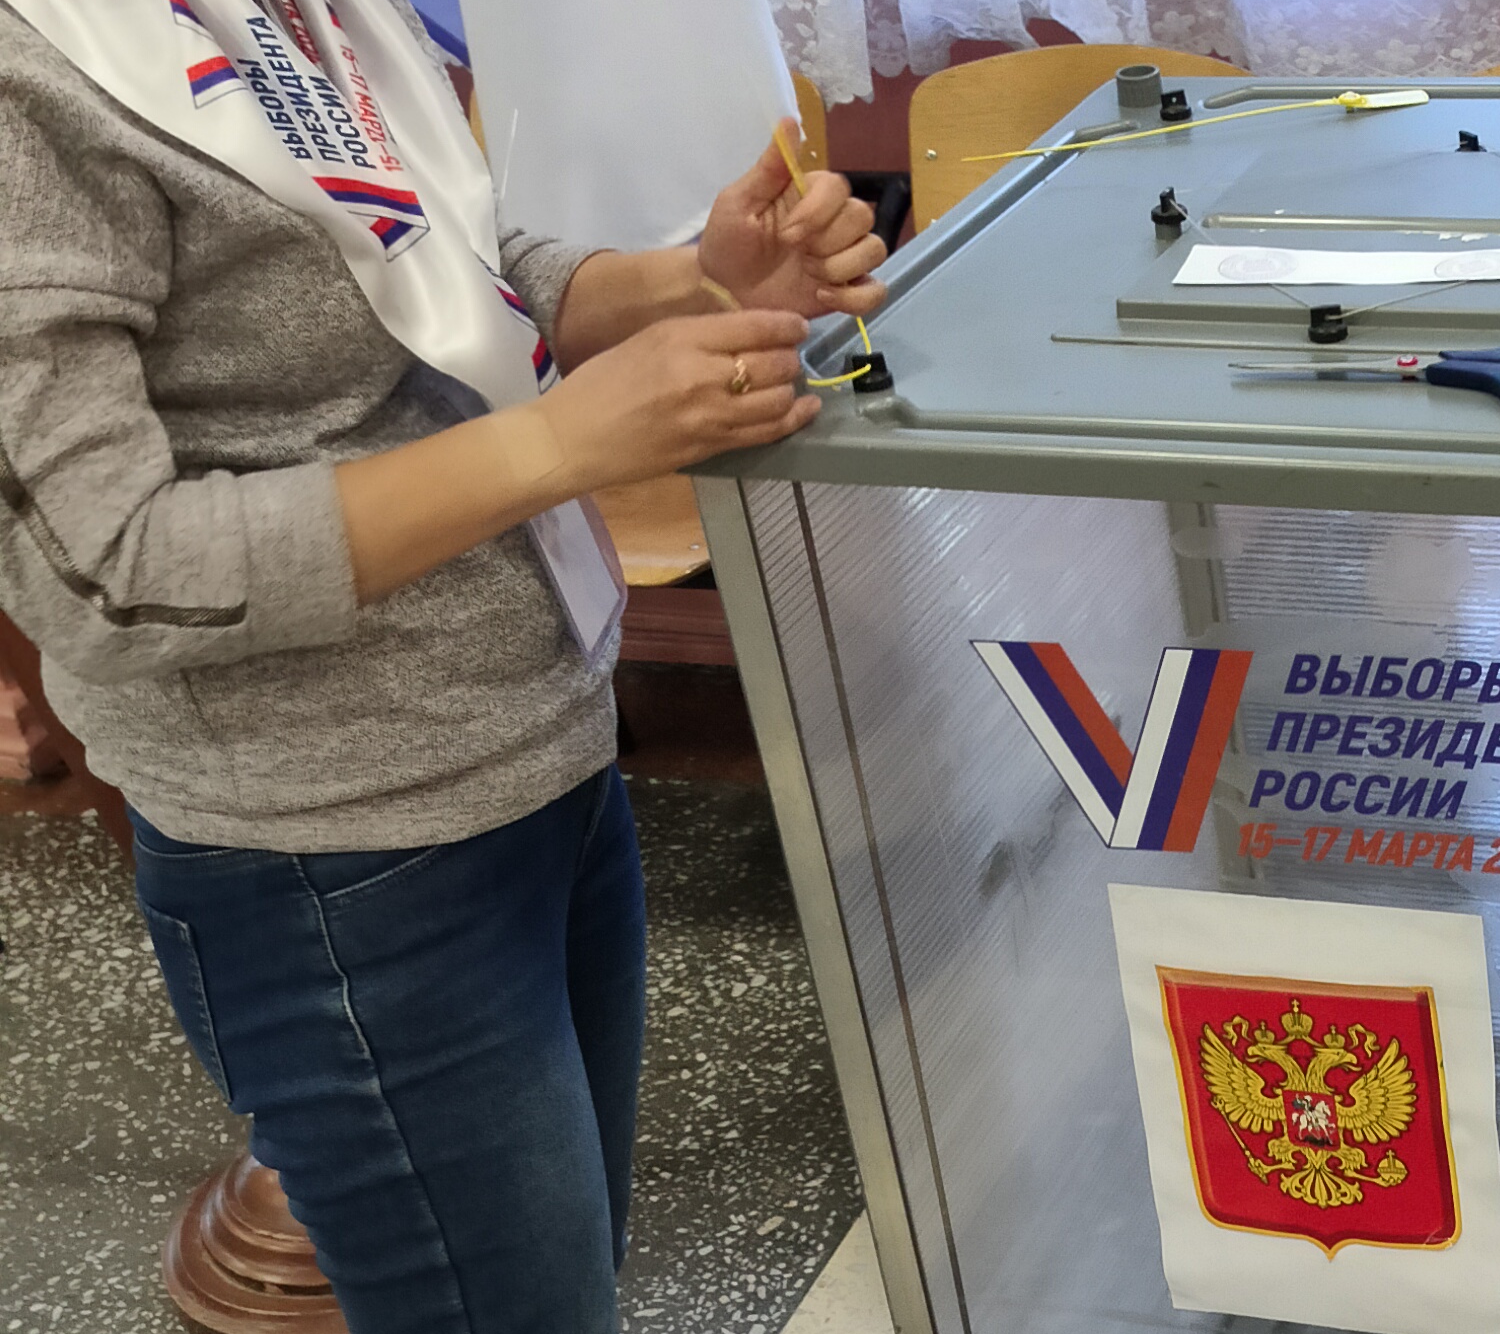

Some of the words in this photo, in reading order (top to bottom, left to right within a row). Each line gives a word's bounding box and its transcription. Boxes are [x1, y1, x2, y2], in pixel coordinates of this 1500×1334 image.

[237, 58, 314, 160] ВЫБОРЫ
[246, 16, 346, 164] ПРЕЗИДЕНТА
[309, 75, 378, 170] РОССИИ
[1248, 769, 1468, 819] РОССИИ
[1345, 828, 1477, 873] МАРТА
